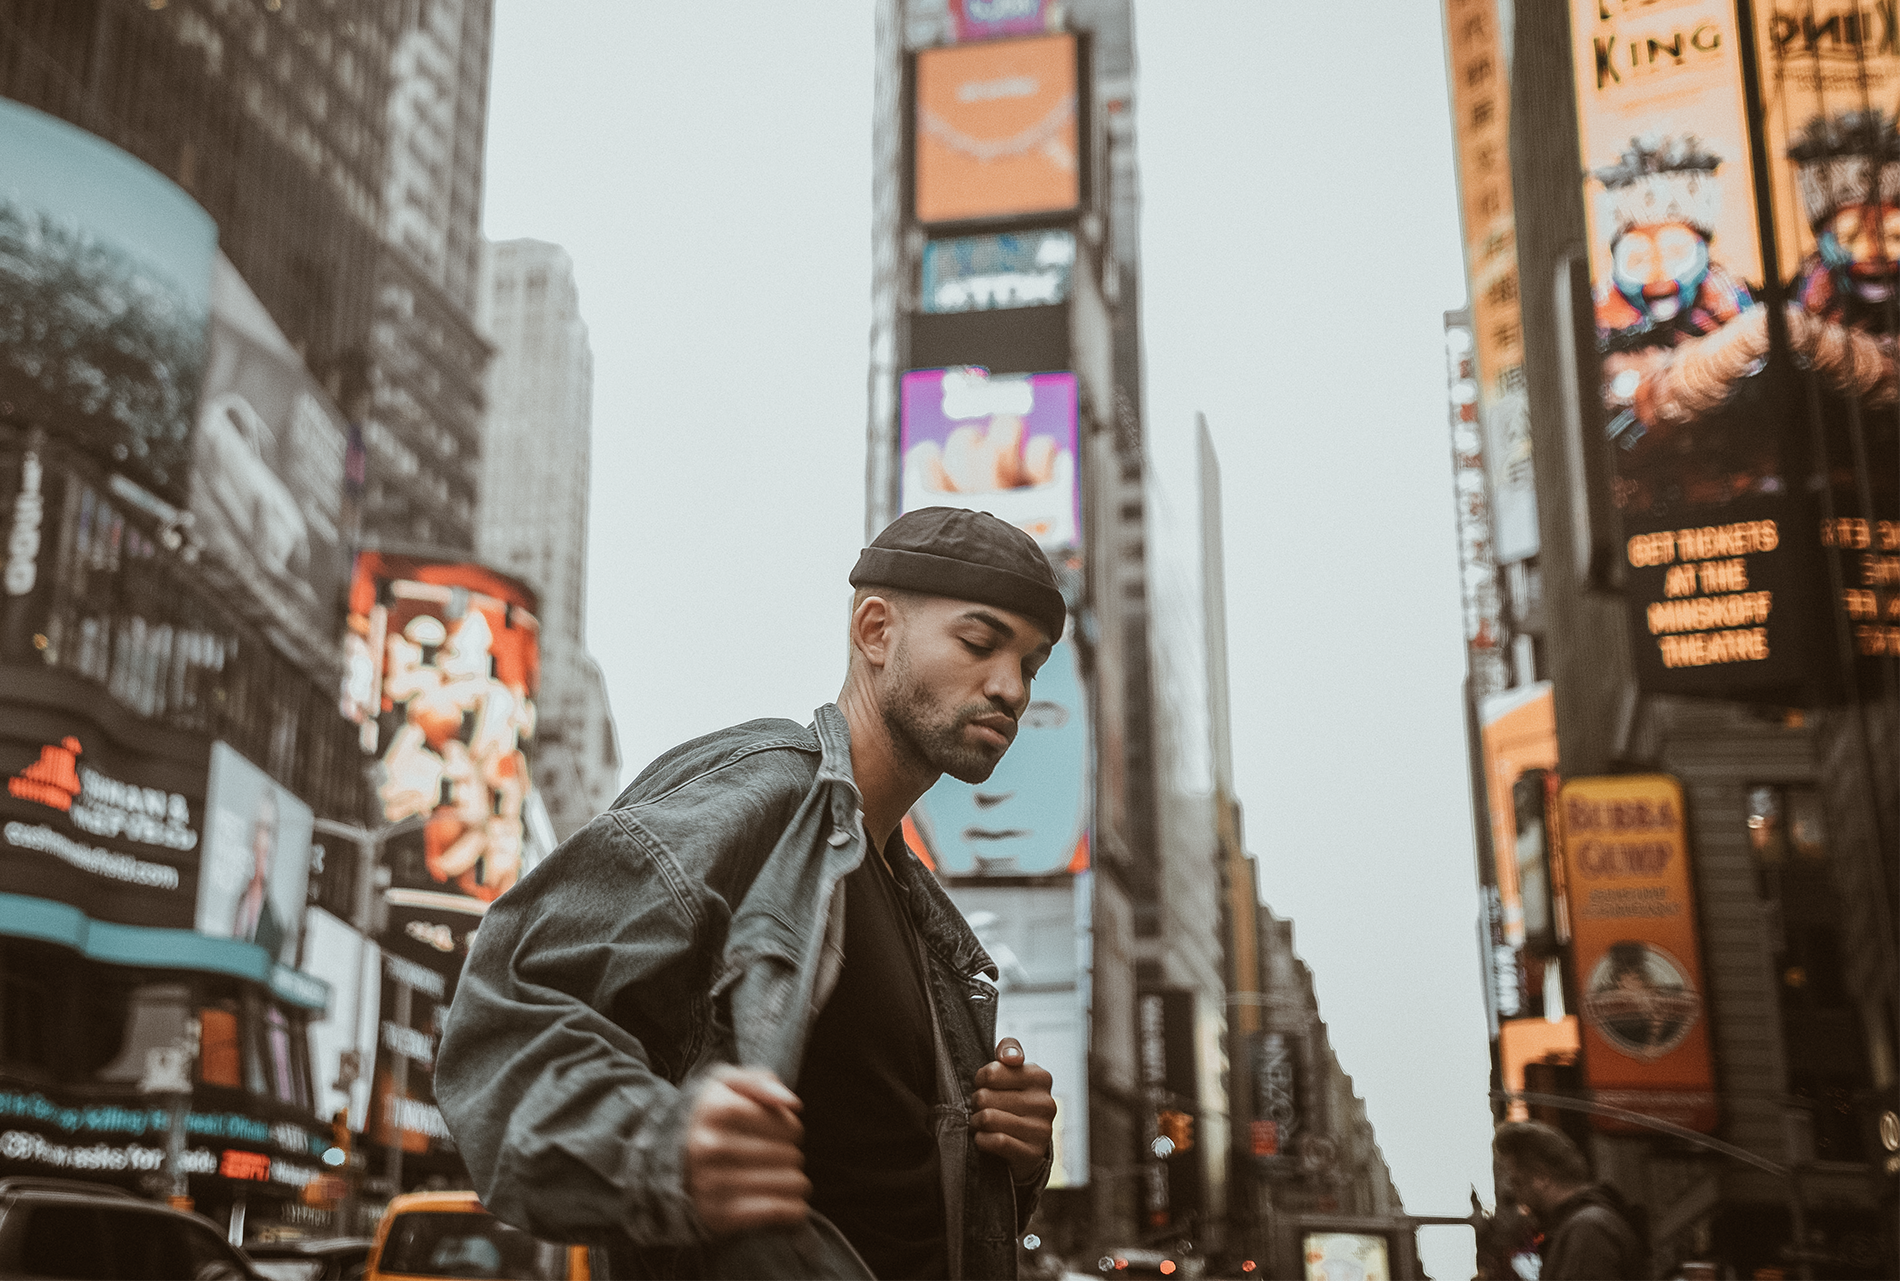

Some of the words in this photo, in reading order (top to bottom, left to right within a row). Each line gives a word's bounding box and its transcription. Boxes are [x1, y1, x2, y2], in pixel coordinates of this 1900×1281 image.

[1593, 25, 1722, 90] KING
[1628, 534, 1675, 568] GET
[1676, 519, 1779, 562] TICKETS
[1664, 563, 1697, 599] AT
[1699, 557, 1749, 594] THE
[1647, 590, 1773, 635] MINSKOFF
[1657, 627, 1770, 669] THEATRE
